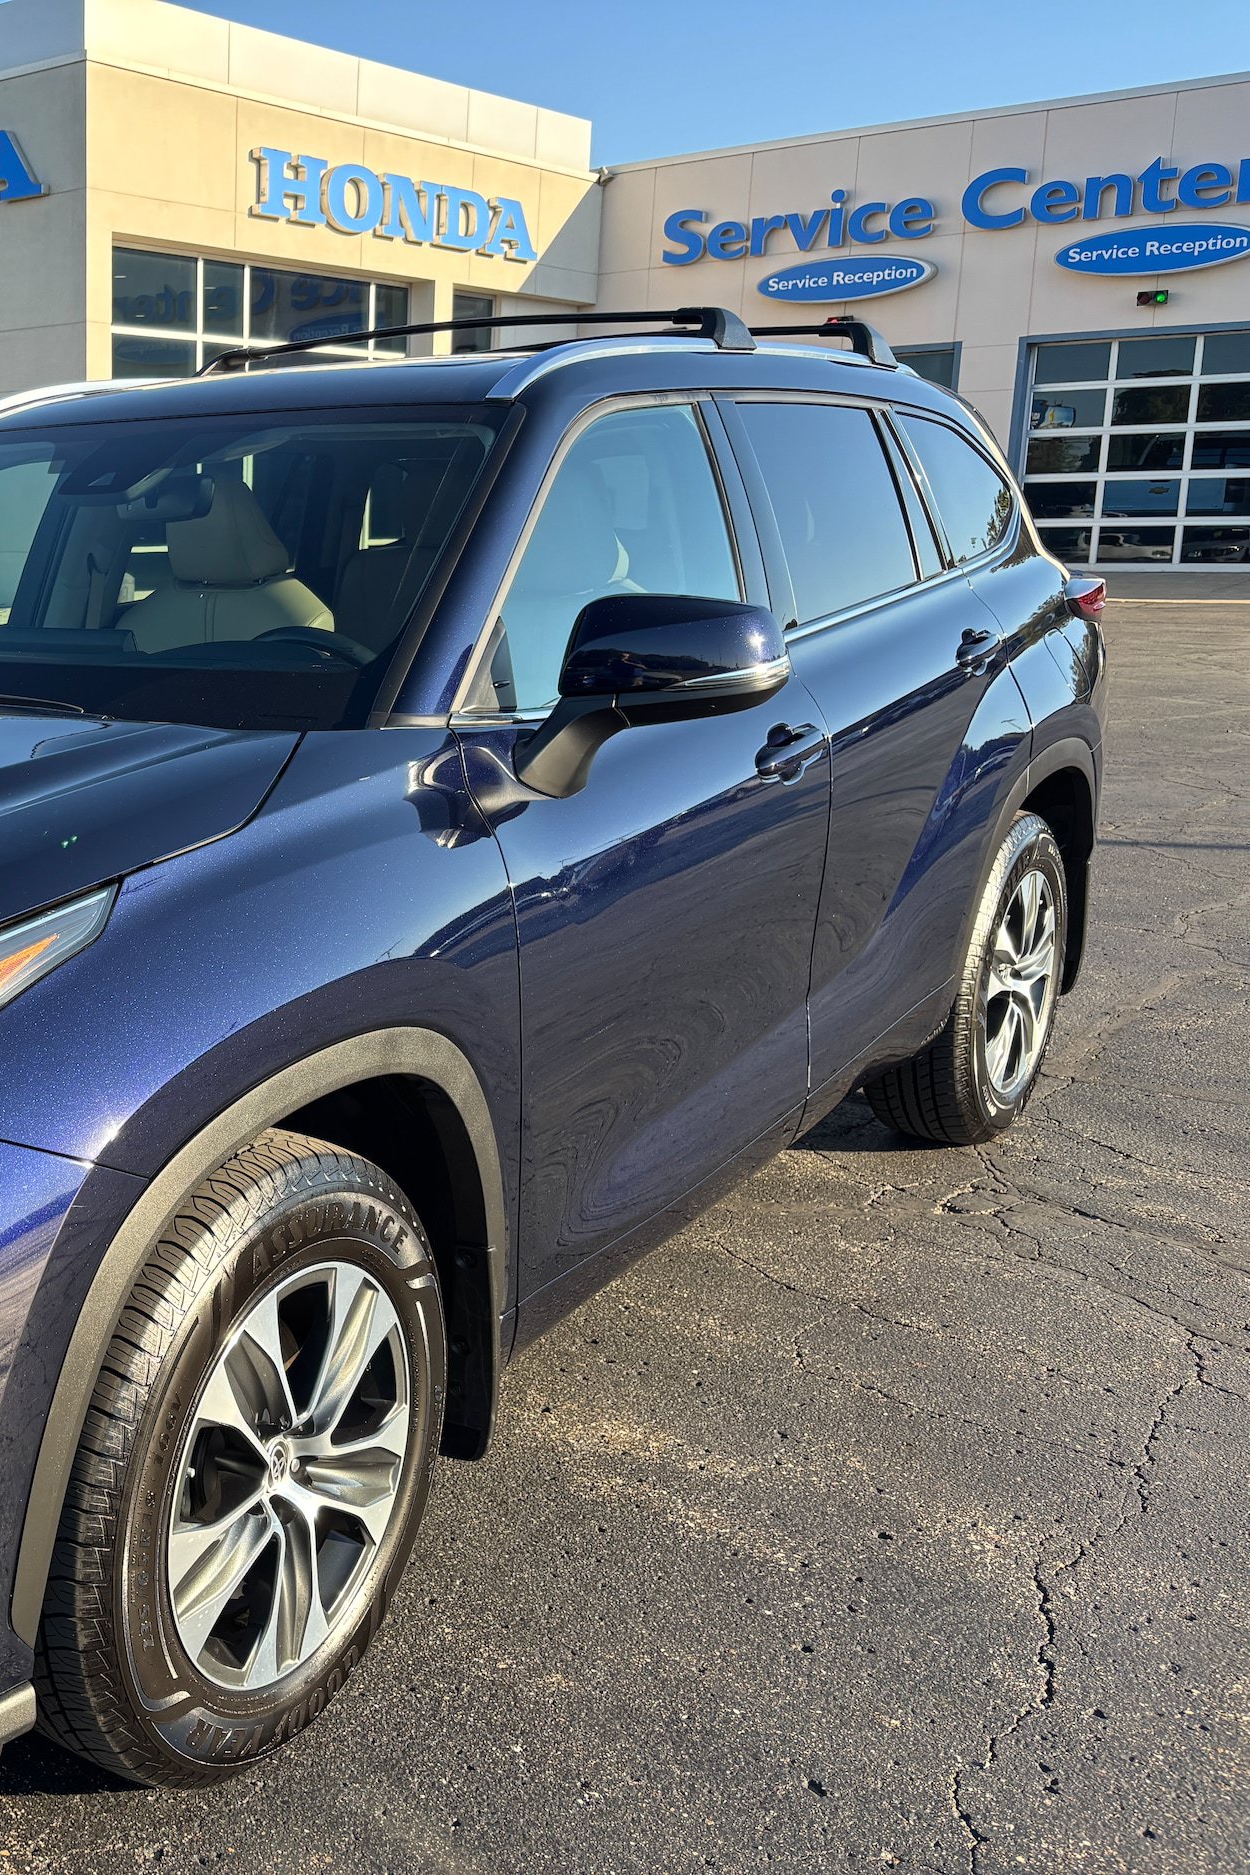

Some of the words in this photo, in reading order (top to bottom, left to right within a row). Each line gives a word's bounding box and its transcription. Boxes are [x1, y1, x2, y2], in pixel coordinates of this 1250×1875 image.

[250, 146, 537, 262] HONDA
[662, 189, 935, 266] Service
[768, 275, 828, 292] Service
[832, 266, 917, 286] Reception
[1068, 245, 1140, 263] Service
[1145, 235, 1249, 256] Reception
[252, 1201, 409, 1282] ASSURANCE
